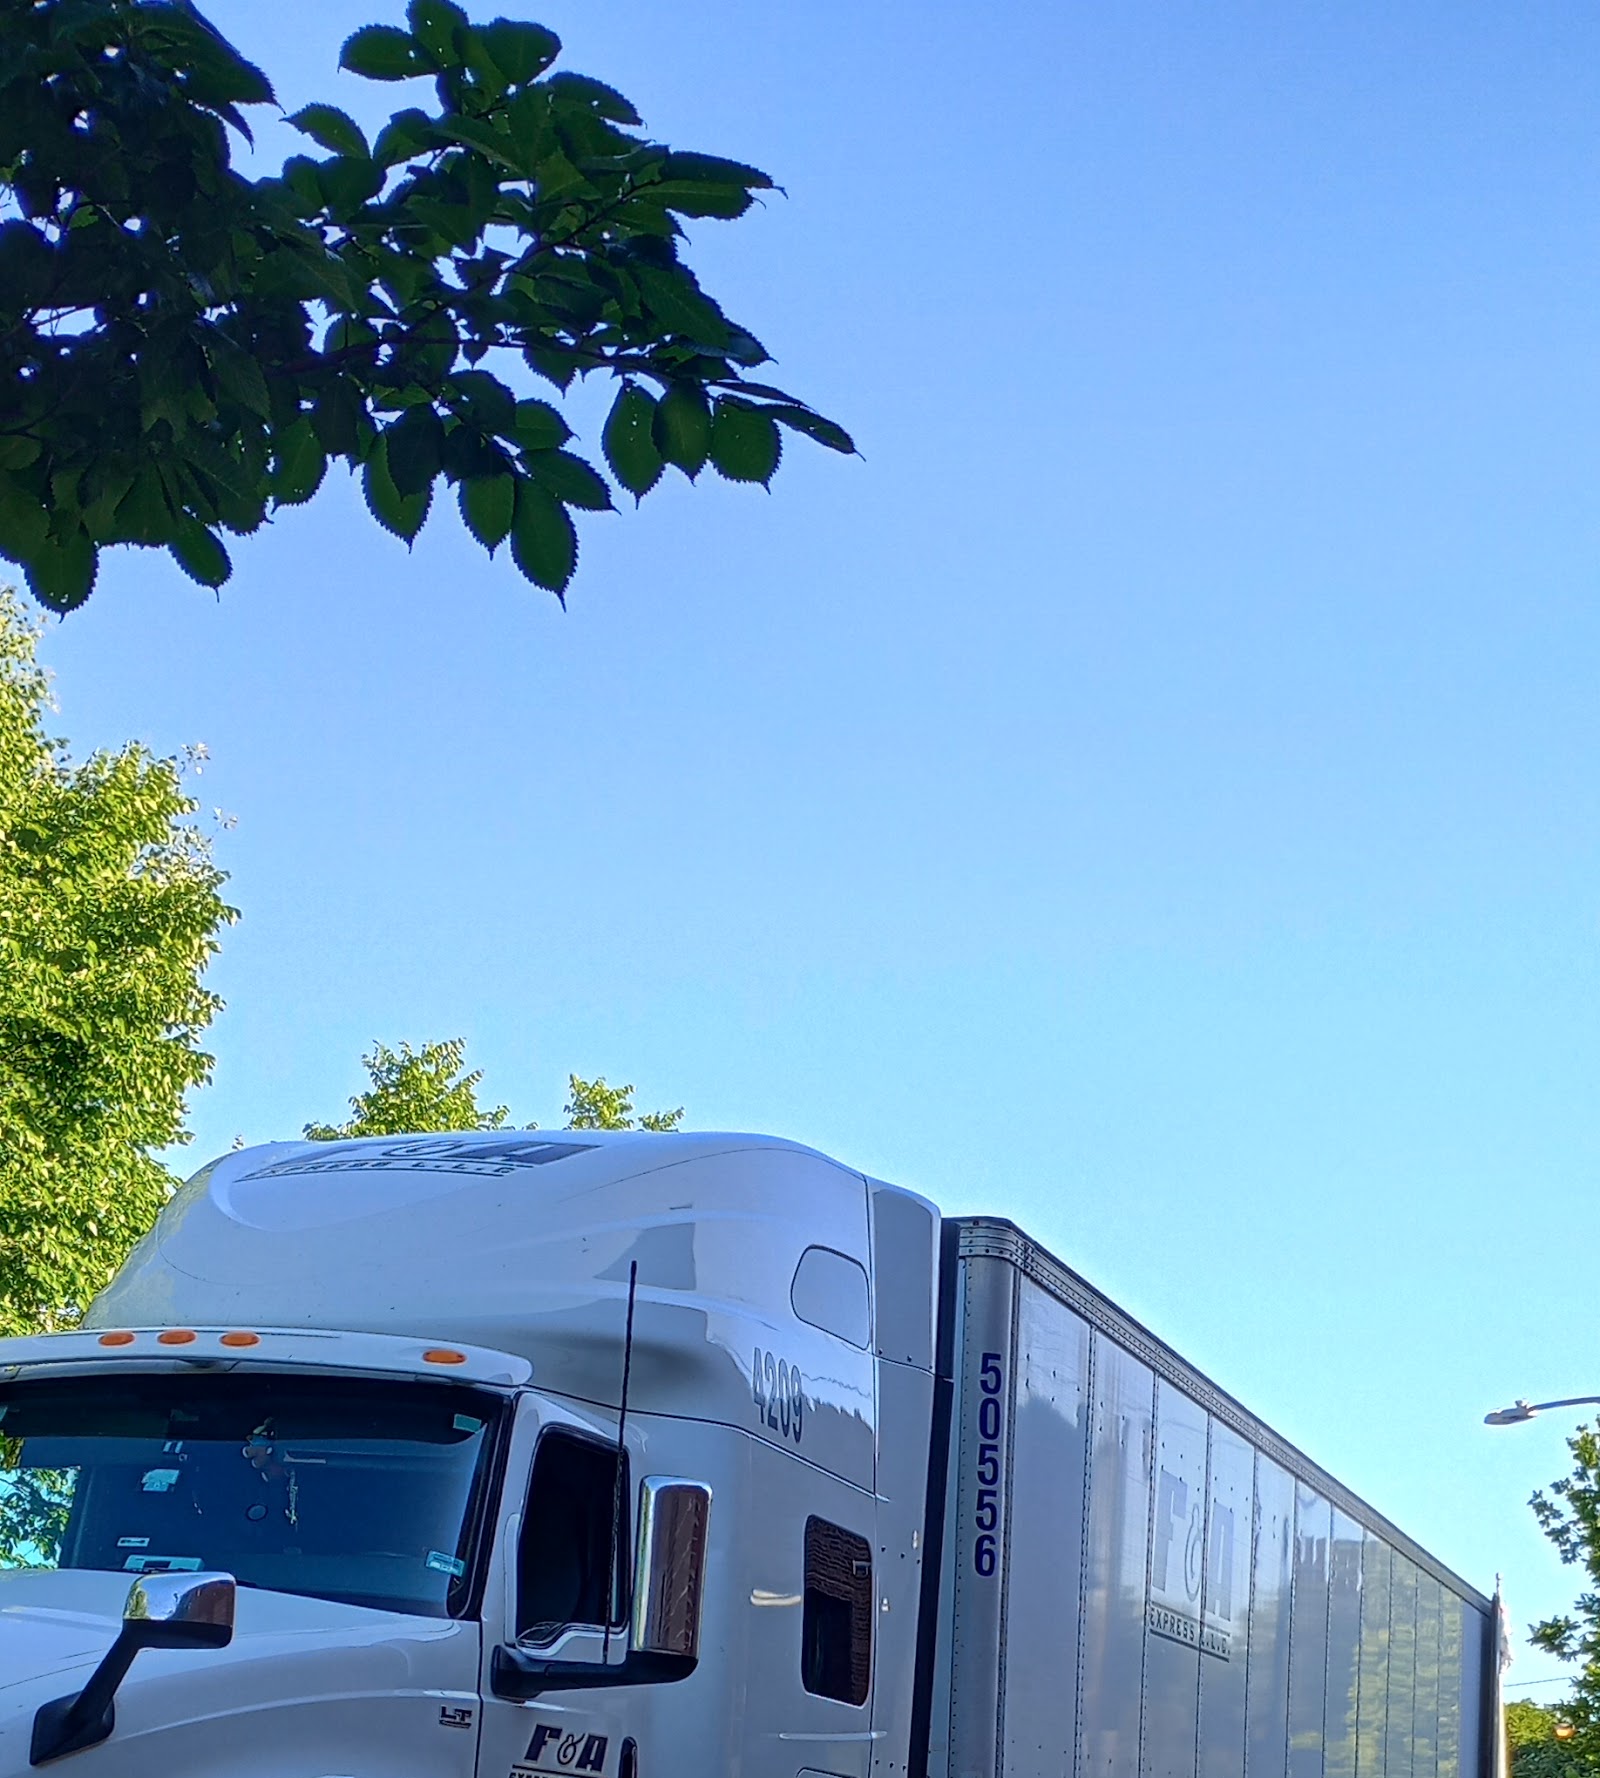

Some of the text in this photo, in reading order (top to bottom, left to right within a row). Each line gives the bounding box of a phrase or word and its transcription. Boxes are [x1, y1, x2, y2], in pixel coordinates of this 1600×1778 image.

[752, 1346, 803, 1444] 4209
[974, 1351, 1002, 1578] 50556
[1149, 1606, 1195, 1642] EXPRESS
[441, 1706, 473, 1722] LT
